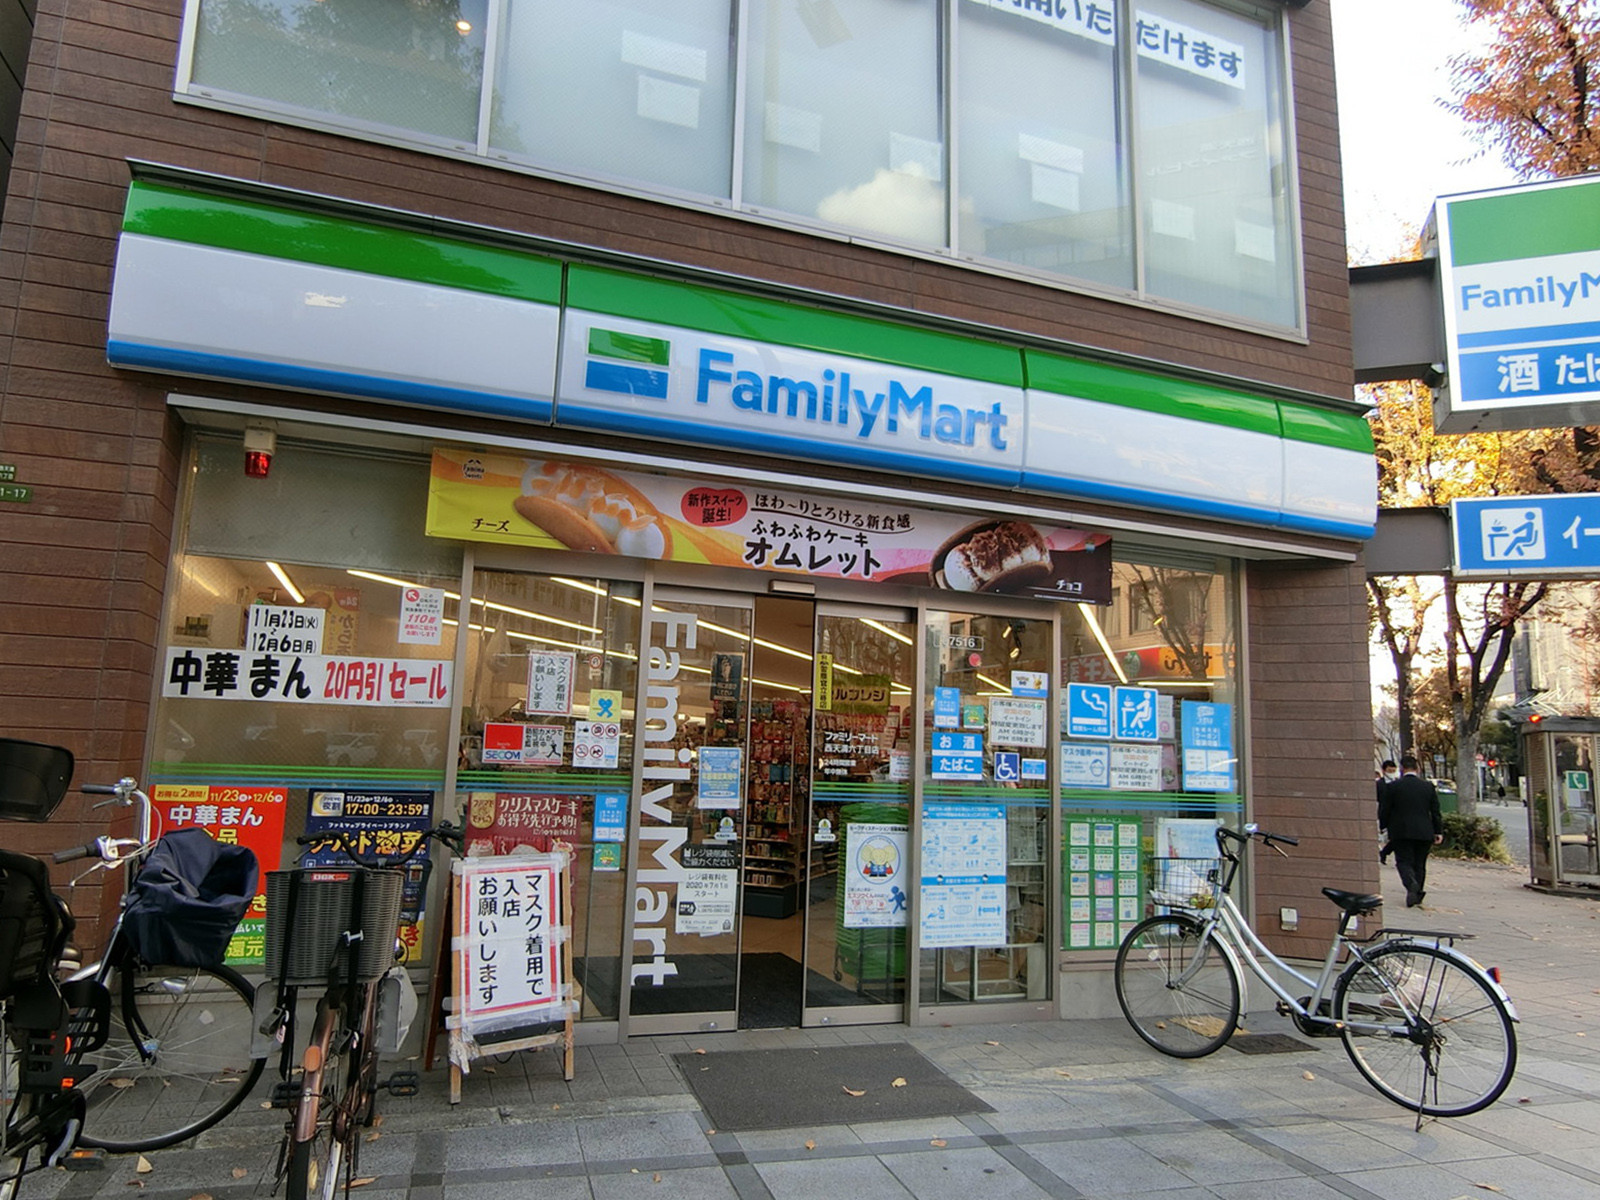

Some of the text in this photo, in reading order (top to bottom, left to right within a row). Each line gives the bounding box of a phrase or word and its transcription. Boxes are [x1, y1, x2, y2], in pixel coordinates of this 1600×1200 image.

[1136, 19, 1243, 78] だけます
[1497, 353, 1541, 393] 酒
[696, 347, 1007, 451] FamilyMart
[687, 493, 743, 507] 新作スイーツ
[702, 507, 732, 523] 誕生!
[472, 518, 510, 532] チーズ
[751, 519, 869, 548] ふわふわケーキ
[745, 537, 881, 576] オムレット
[1056, 579, 1082, 591] チョコ
[254, 608, 318, 629] 11月23日(火)
[252, 633, 316, 653] 12月6日(月)
[832, 689, 885, 702] ルフレジ
[824, 732, 879, 743] ファミリーマート
[485, 751, 521, 760] SECOM
[940, 758, 974, 772] たばこ
[210, 789, 283, 802] 11/23 12/6
[632, 612, 698, 986] FamilyMart
[170, 804, 264, 826] 中華まん
[500, 796, 578, 815] クリスマスケーキ
[498, 812, 578, 828] お得な先行予約!
[202, 827, 238, 845] 品
[683, 858, 735, 867] ご協力ください
[502, 879, 521, 918] 入店
[478, 877, 499, 1004] お願いします
[525, 874, 544, 995] マスク着用で
